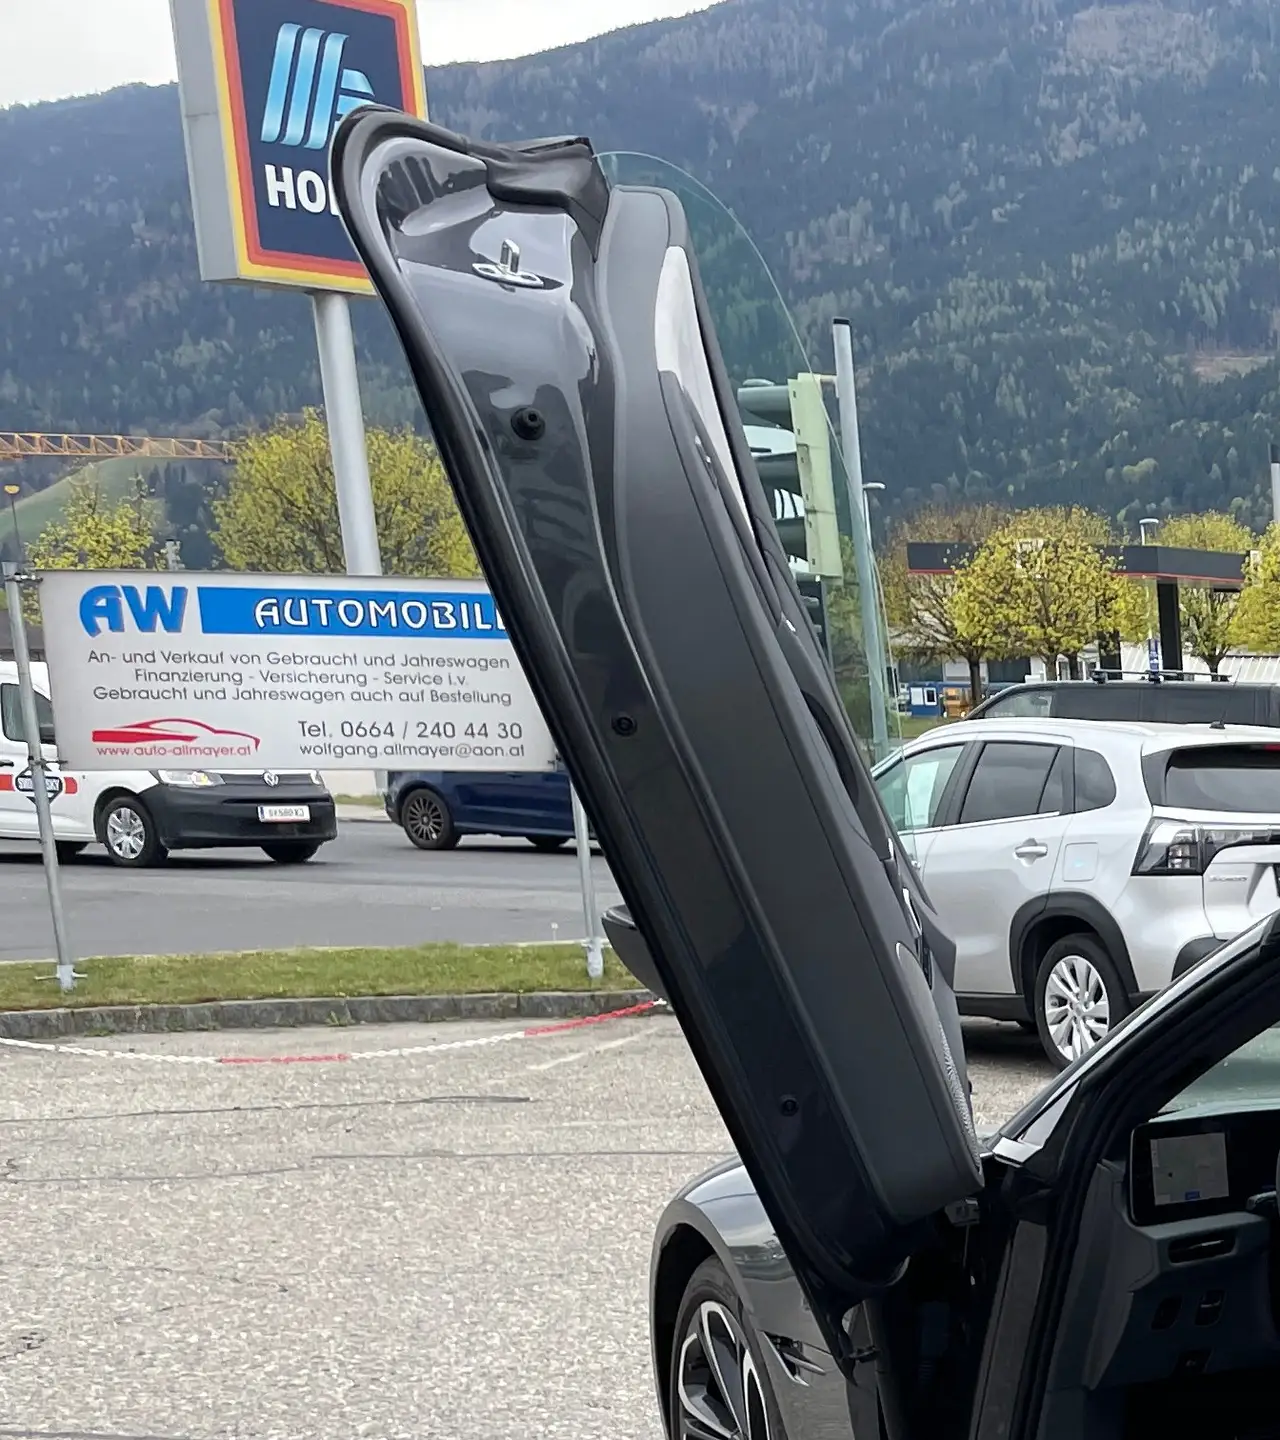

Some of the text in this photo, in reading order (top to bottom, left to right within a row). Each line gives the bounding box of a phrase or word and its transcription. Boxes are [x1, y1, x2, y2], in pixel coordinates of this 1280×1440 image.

[79, 584, 189, 637] AW
[87, 649, 511, 672] An- und Verkauf von Gebraucht und Jahreswagen
[134, 668, 244, 686] Finanzierung
[259, 670, 368, 688] Versicherung
[383, 671, 444, 686] Service
[93, 686, 512, 707] Gebraucht und Jahreswagen auch auf Bestellung
[298, 720, 334, 738] Tel.
[340, 721, 395, 738] 0664
[416, 722, 456, 739] 240
[464, 722, 489, 739] 44
[497, 722, 523, 740] 30
[97, 744, 251, 758] www.auto-allmayer.at
[299, 743, 525, 758] wolfgang.allmayer@aon.at
